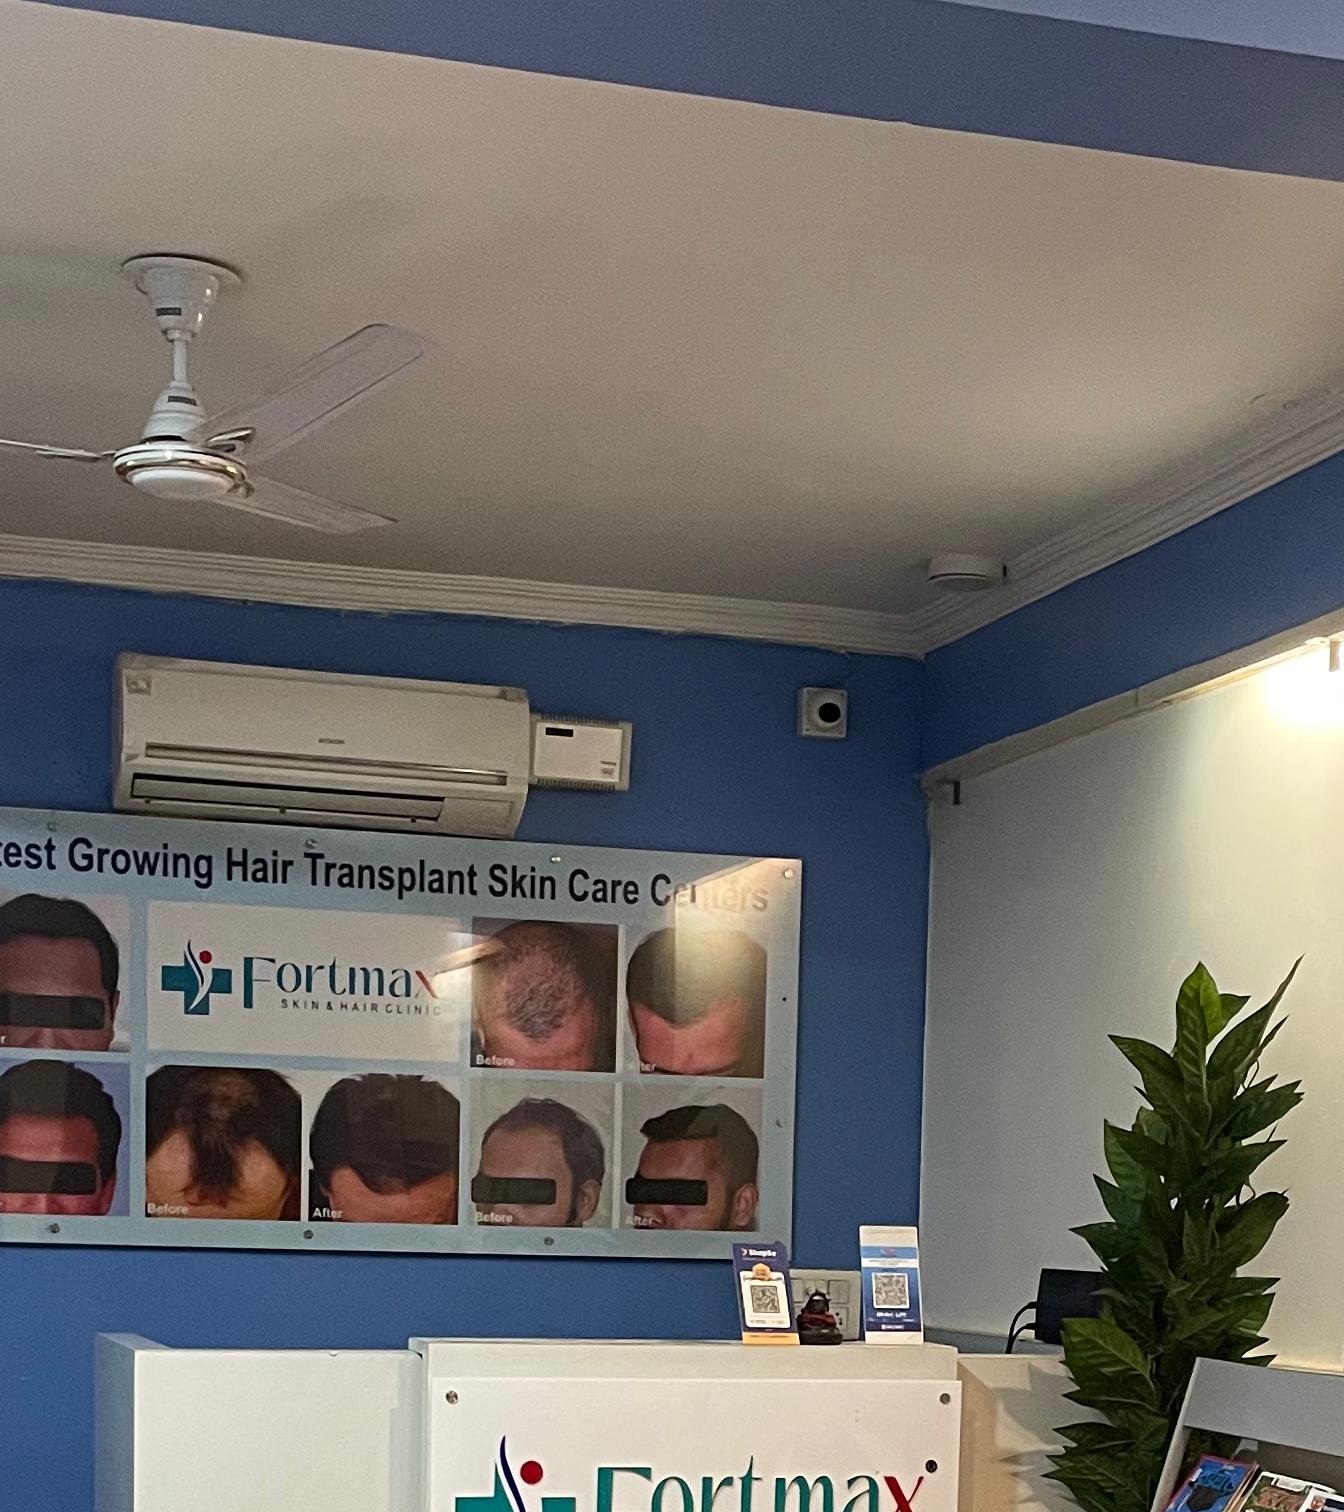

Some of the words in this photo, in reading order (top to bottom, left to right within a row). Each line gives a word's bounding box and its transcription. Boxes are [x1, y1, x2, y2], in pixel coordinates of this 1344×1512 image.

[67, 836, 214, 889] Growing
[225, 846, 294, 886] Hair
[304, 851, 478, 900] Transplant
[488, 863, 557, 900] Skin
[568, 869, 640, 905] Care
[281, 999, 320, 1010] SKIN
[340, 1001, 379, 1013] HAIR
[385, 1004, 442, 1016] CLINIC
[475, 1055, 516, 1067] Before
[147, 1202, 189, 1215] Before
[312, 1206, 343, 1220] After
[474, 1212, 514, 1223] Before
